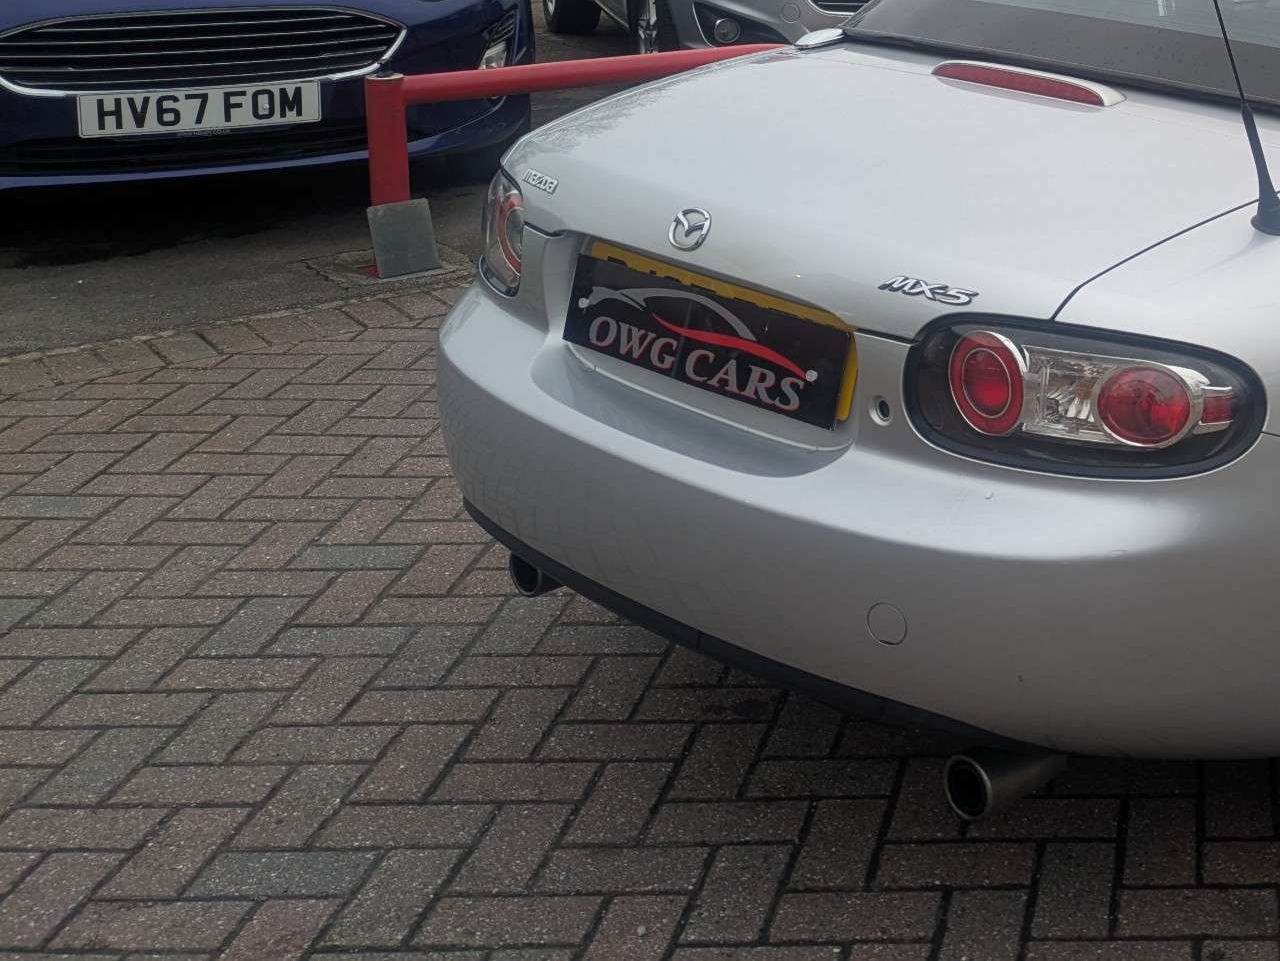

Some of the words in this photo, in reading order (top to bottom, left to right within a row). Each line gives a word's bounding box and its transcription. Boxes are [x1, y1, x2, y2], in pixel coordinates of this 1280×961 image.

[96, 92, 209, 131] HV67
[223, 86, 303, 123] FOM
[588, 315, 679, 370] OWG
[684, 349, 805, 412] CARS
